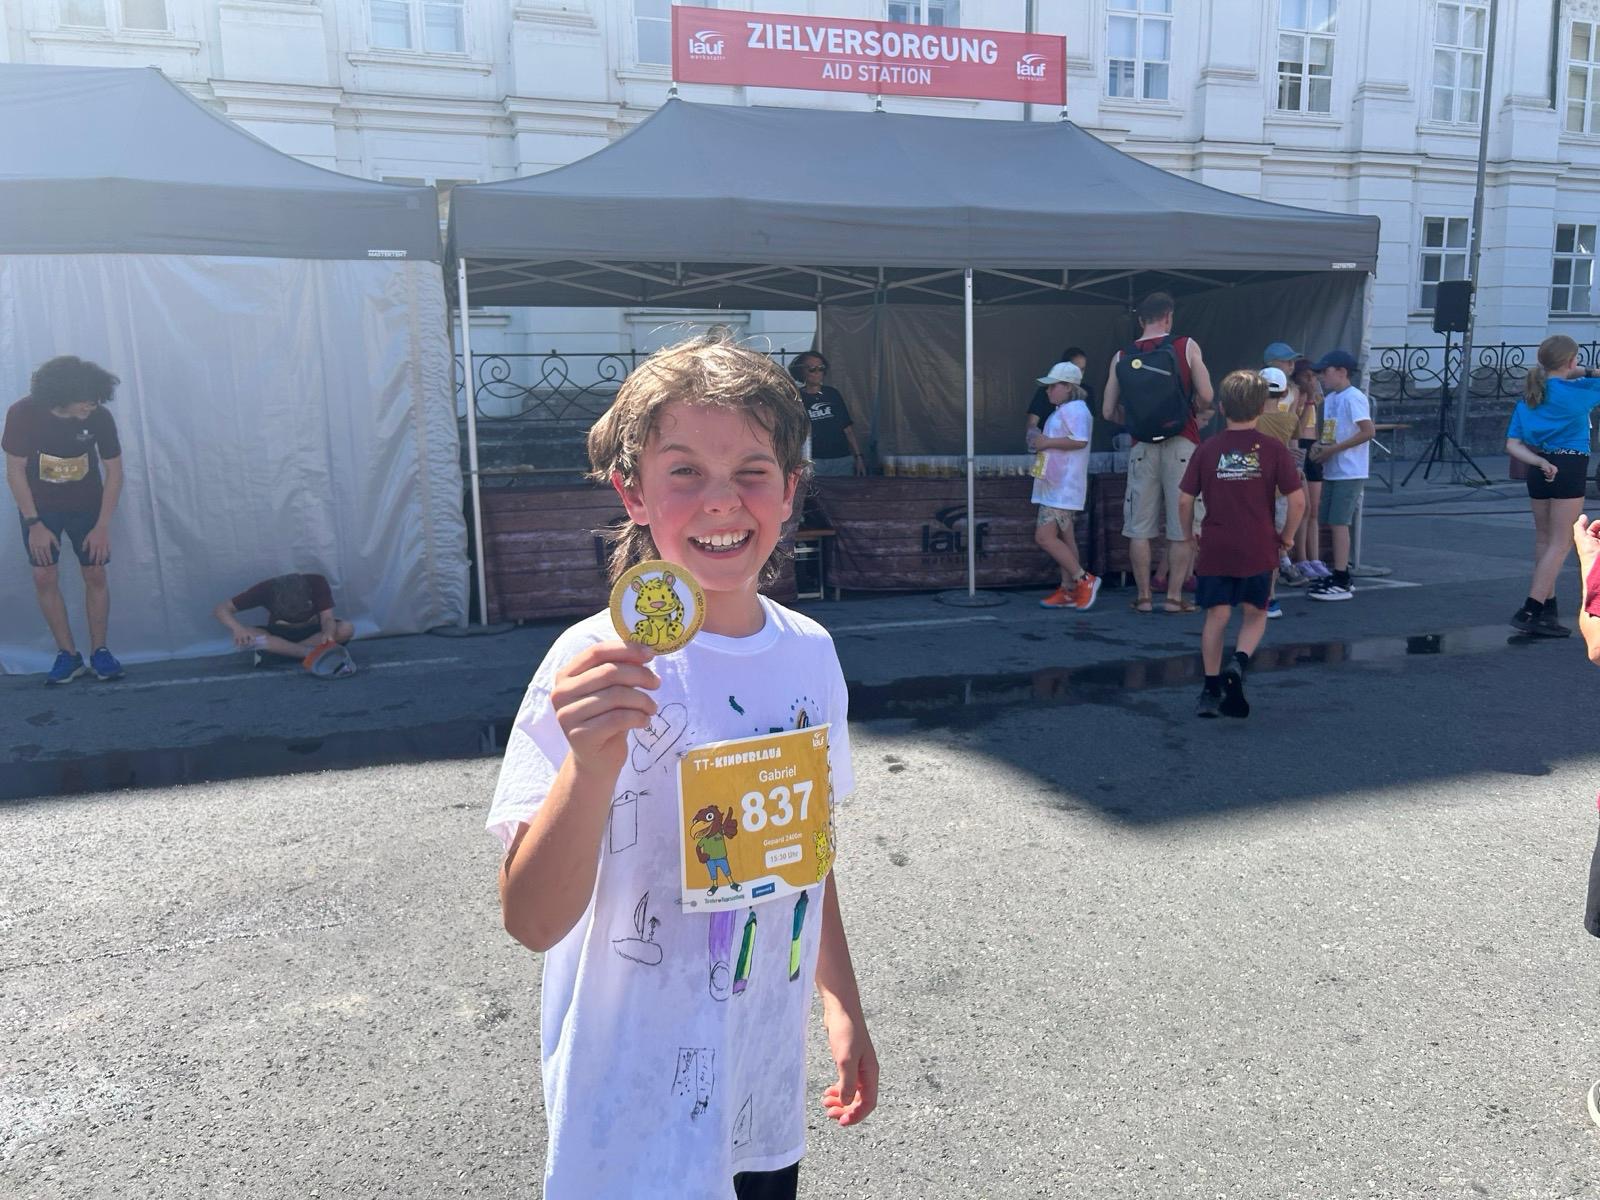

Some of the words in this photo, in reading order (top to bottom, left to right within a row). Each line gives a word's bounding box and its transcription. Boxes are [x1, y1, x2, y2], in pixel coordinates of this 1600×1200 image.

[689, 38, 724, 55] lauf
[747, 22, 998, 65] ZIELVERSORGUNG
[822, 62, 852, 79] AID
[858, 64, 931, 85] STATION
[1016, 61, 1046, 77] lauf
[808, 406, 832, 418] lauf
[759, 765, 797, 783] Gabriel
[741, 780, 813, 833] 837
